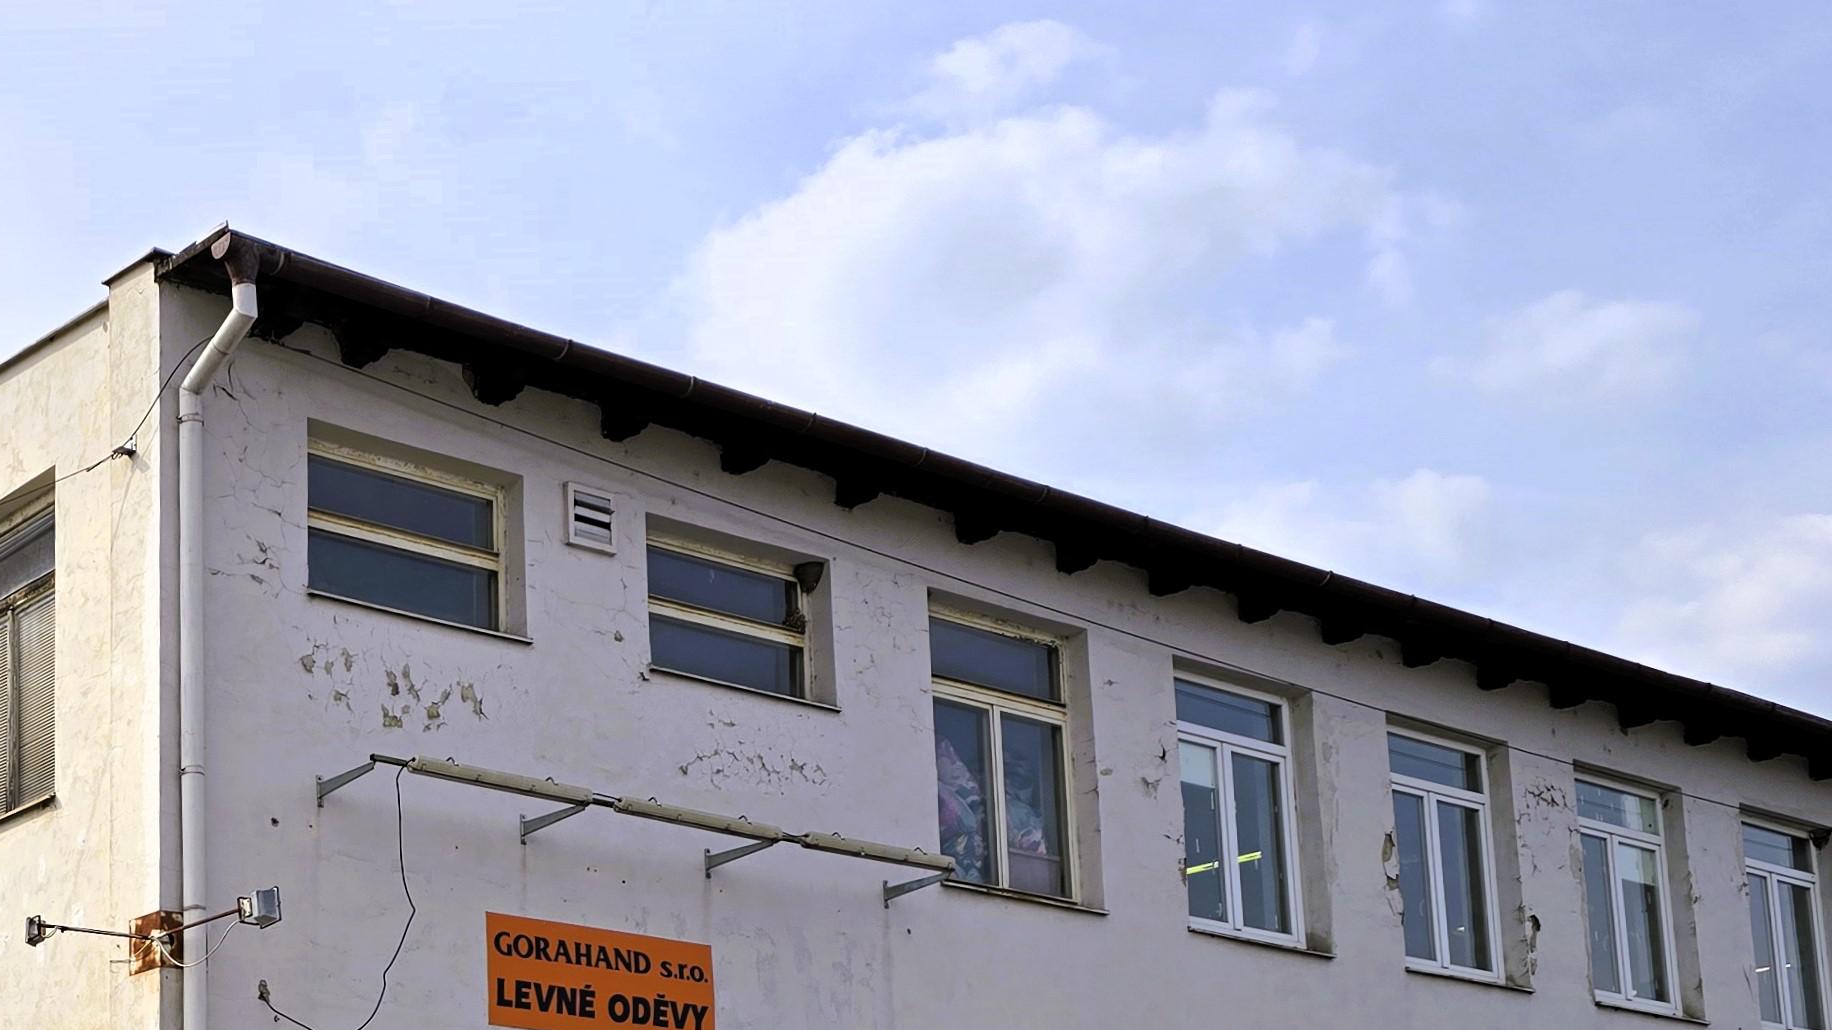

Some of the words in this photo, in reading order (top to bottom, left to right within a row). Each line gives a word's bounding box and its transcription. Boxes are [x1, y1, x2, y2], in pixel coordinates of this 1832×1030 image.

[493, 931, 651, 975] GORAHAND
[659, 959, 709, 983] s.r.o.
[496, 977, 596, 1019] LEVNÉ
